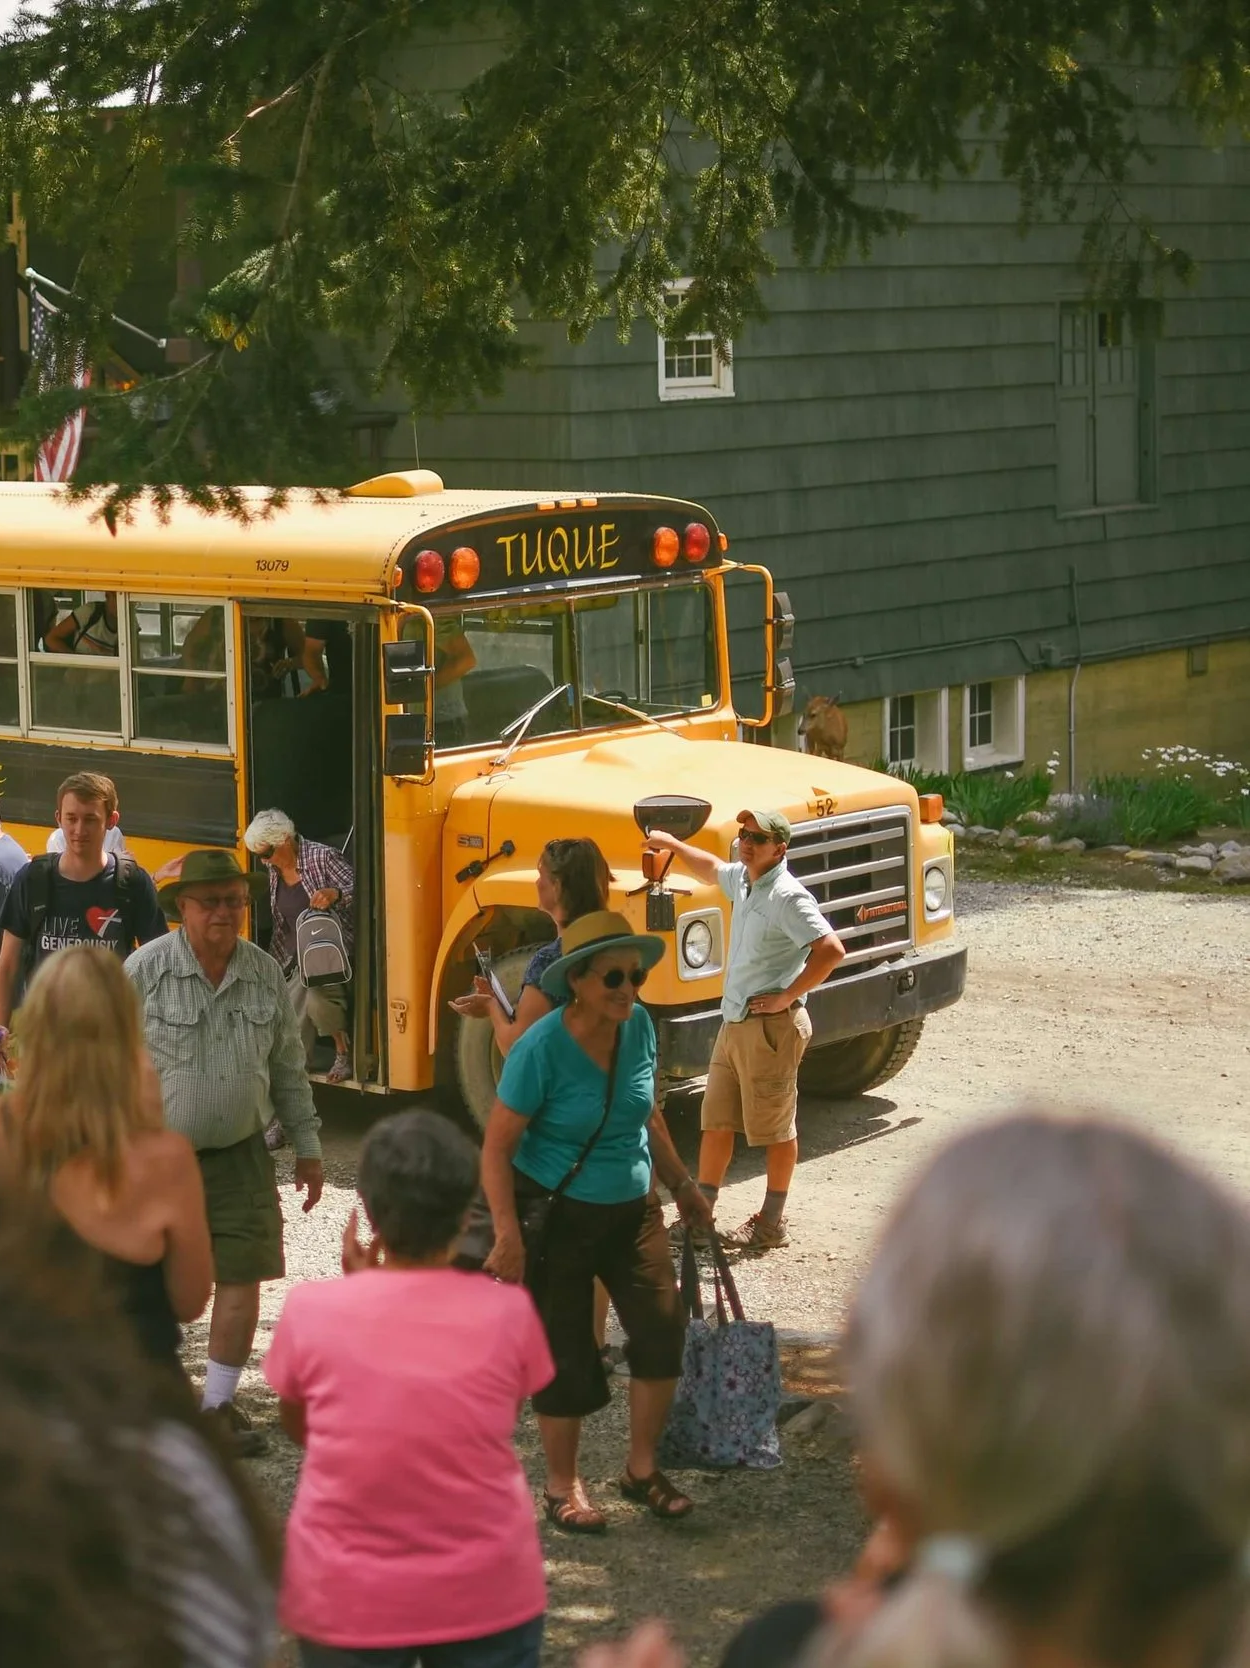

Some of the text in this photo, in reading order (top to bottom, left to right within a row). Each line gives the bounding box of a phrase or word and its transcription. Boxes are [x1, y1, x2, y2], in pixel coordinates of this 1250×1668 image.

[496, 522, 620, 577] TUQUE
[256, 559, 289, 572] 13079
[816, 797, 834, 817] 52
[42, 916, 80, 938] LIVE
